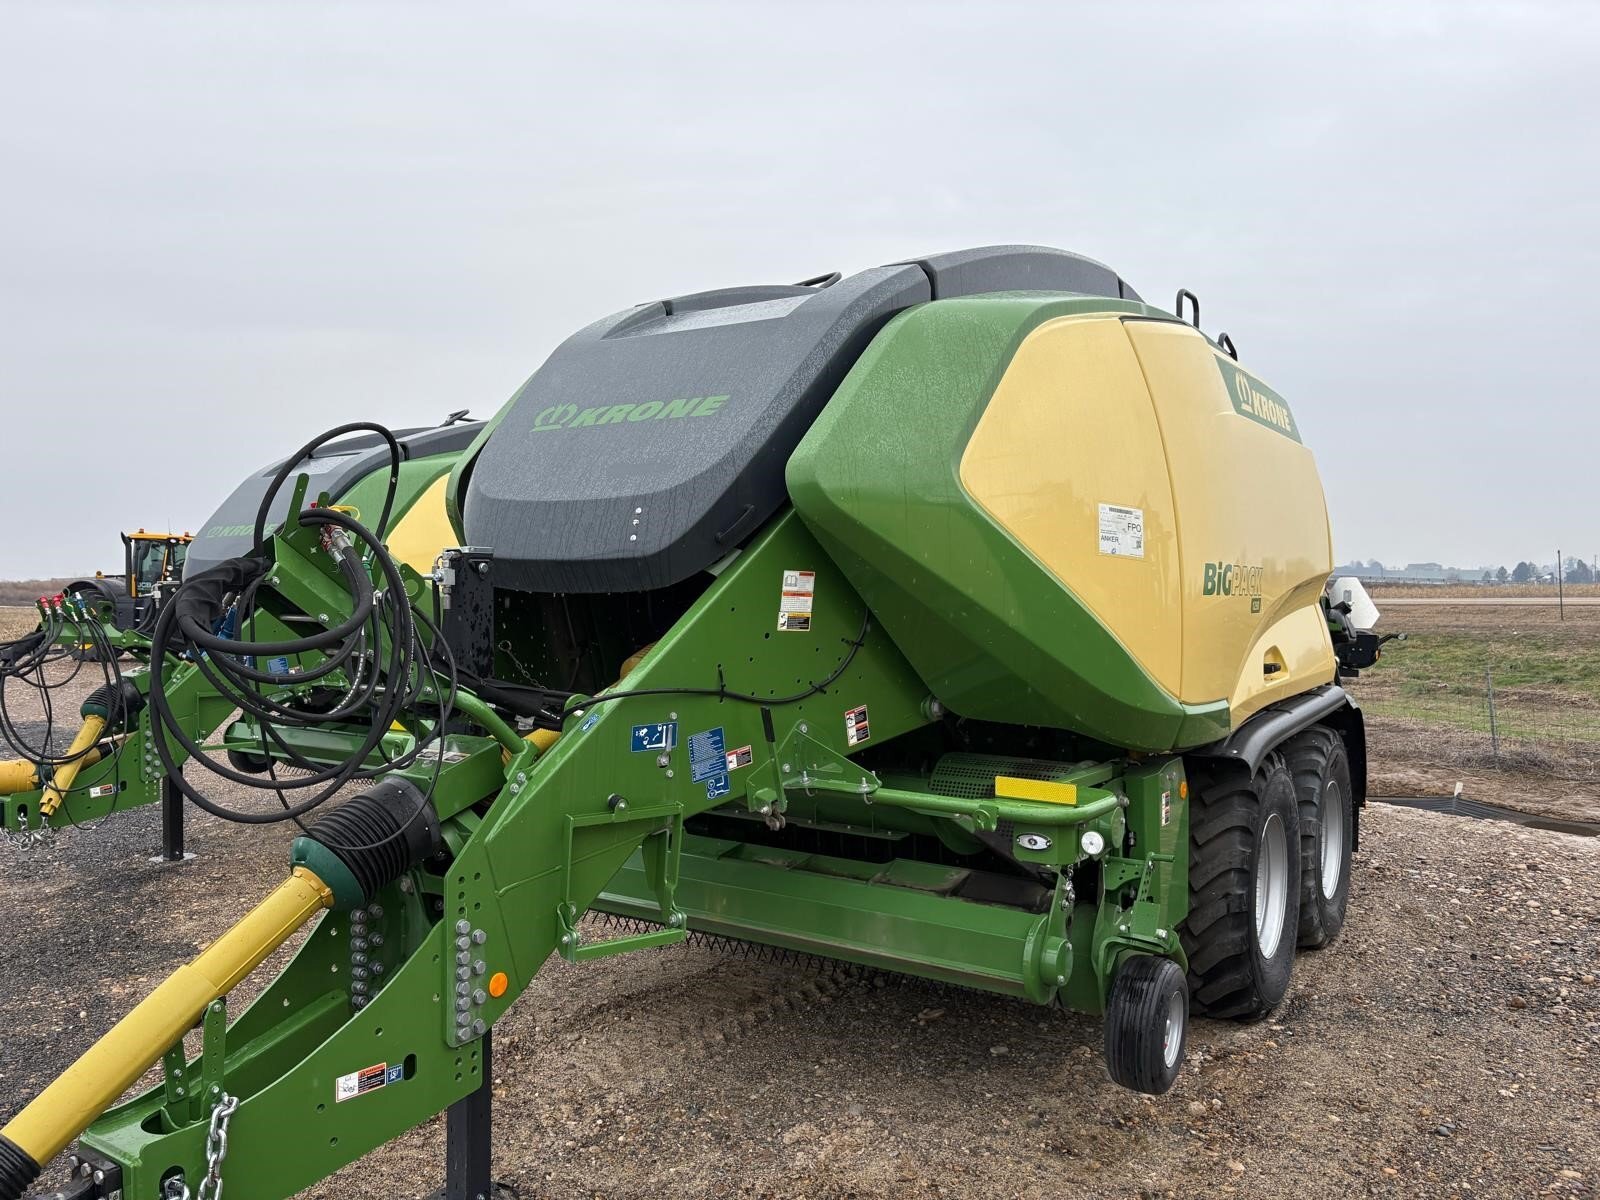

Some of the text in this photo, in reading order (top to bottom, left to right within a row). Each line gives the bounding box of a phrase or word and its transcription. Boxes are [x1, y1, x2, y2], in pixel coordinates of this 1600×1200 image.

[567, 394, 730, 427] KRONE
[1252, 389, 1291, 432] KRONE
[219, 523, 279, 537] KROE
[1127, 522, 1142, 533] FPO
[1100, 534, 1120, 544] ANKER
